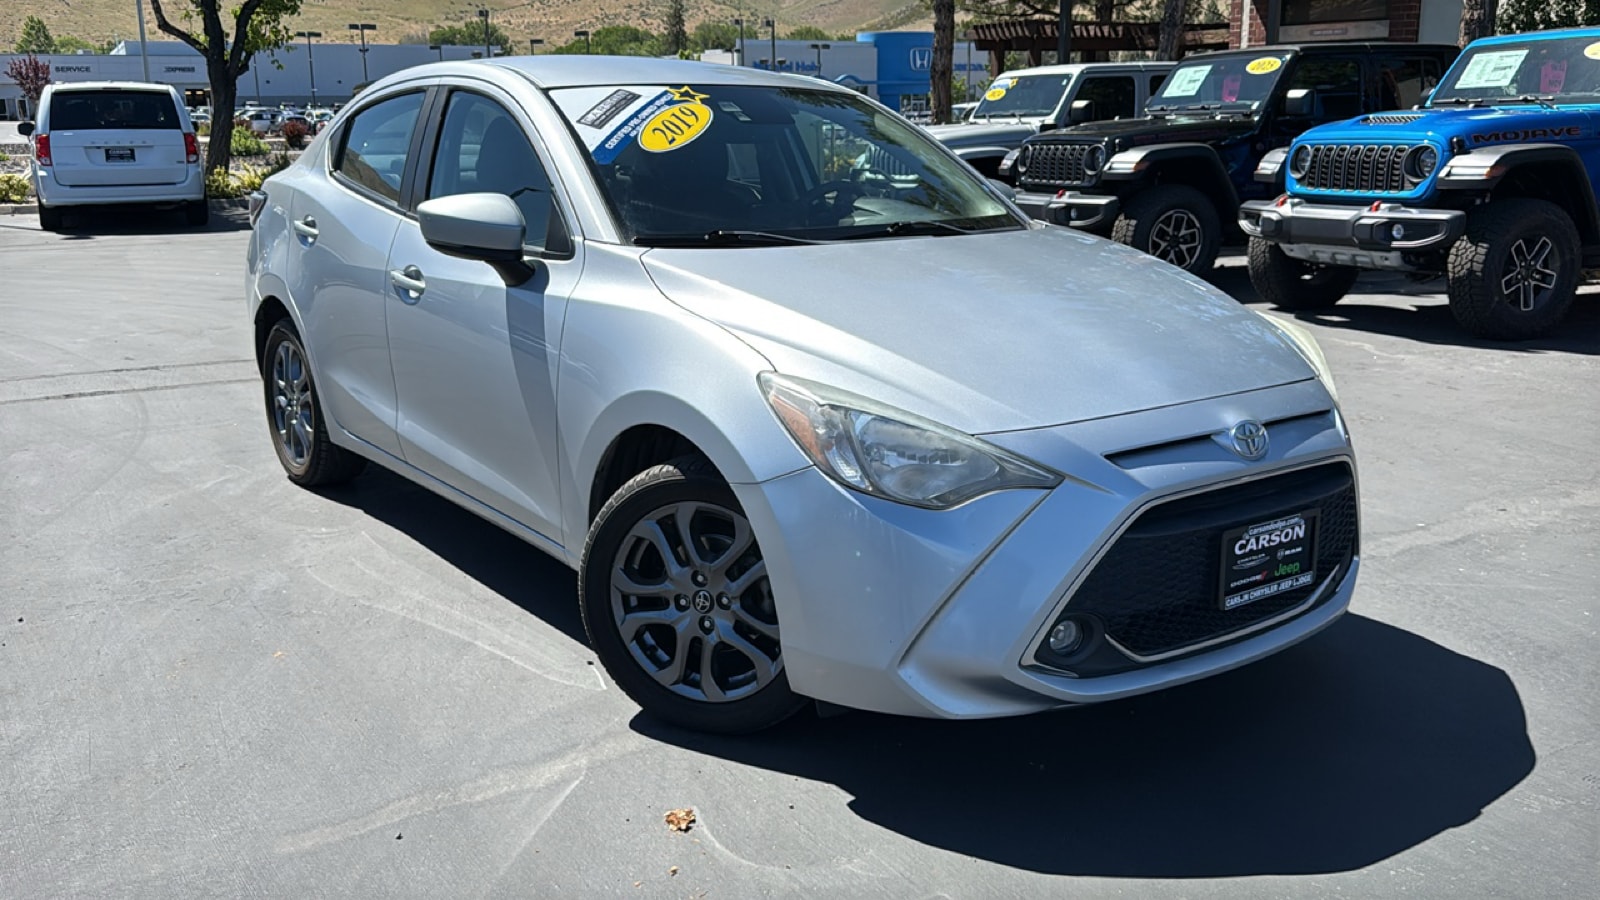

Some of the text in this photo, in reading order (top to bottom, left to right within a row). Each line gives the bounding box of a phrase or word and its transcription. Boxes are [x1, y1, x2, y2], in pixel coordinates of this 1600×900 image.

[652, 106, 699, 145] 2019
[1472, 127, 1580, 144] MOJAVE
[605, 125, 632, 149] CERTIFIED
[1234, 524, 1306, 555] CARSON
[1274, 562, 1300, 577] Jeep
[1249, 584, 1278, 599] CHRYSLER
[1279, 580, 1292, 590] JEEP
